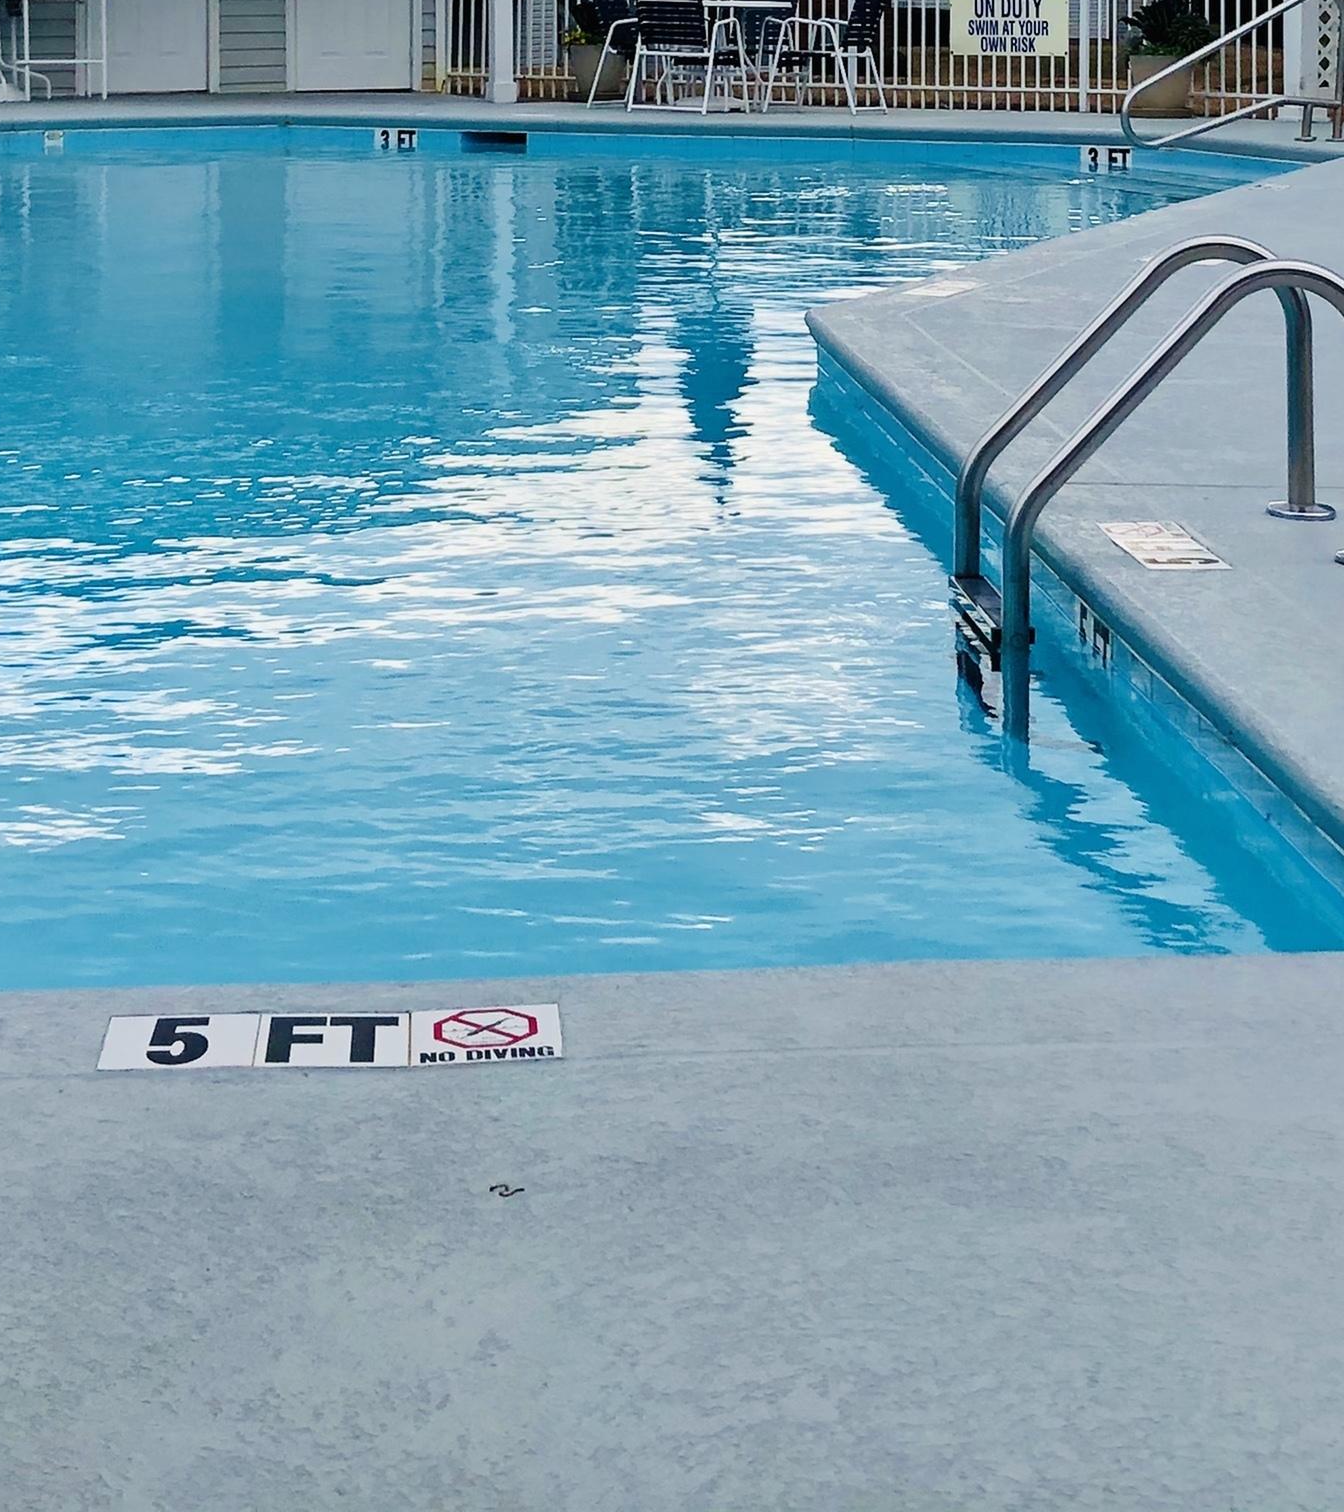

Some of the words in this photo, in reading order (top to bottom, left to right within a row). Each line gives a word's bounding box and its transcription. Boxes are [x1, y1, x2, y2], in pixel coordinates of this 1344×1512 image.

[968, 19, 999, 36] SWIM
[1002, 19, 1015, 36] AT
[1019, 19, 1049, 36] YOUR
[980, 36, 1007, 53] OWN
[1010, 36, 1036, 53] RISK
[1088, 147, 1099, 172] 3
[145, 1016, 211, 1065] 5
[263, 1015, 400, 1064] FT
[419, 1051, 456, 1064] NO
[466, 1045, 555, 1061] DIVING
